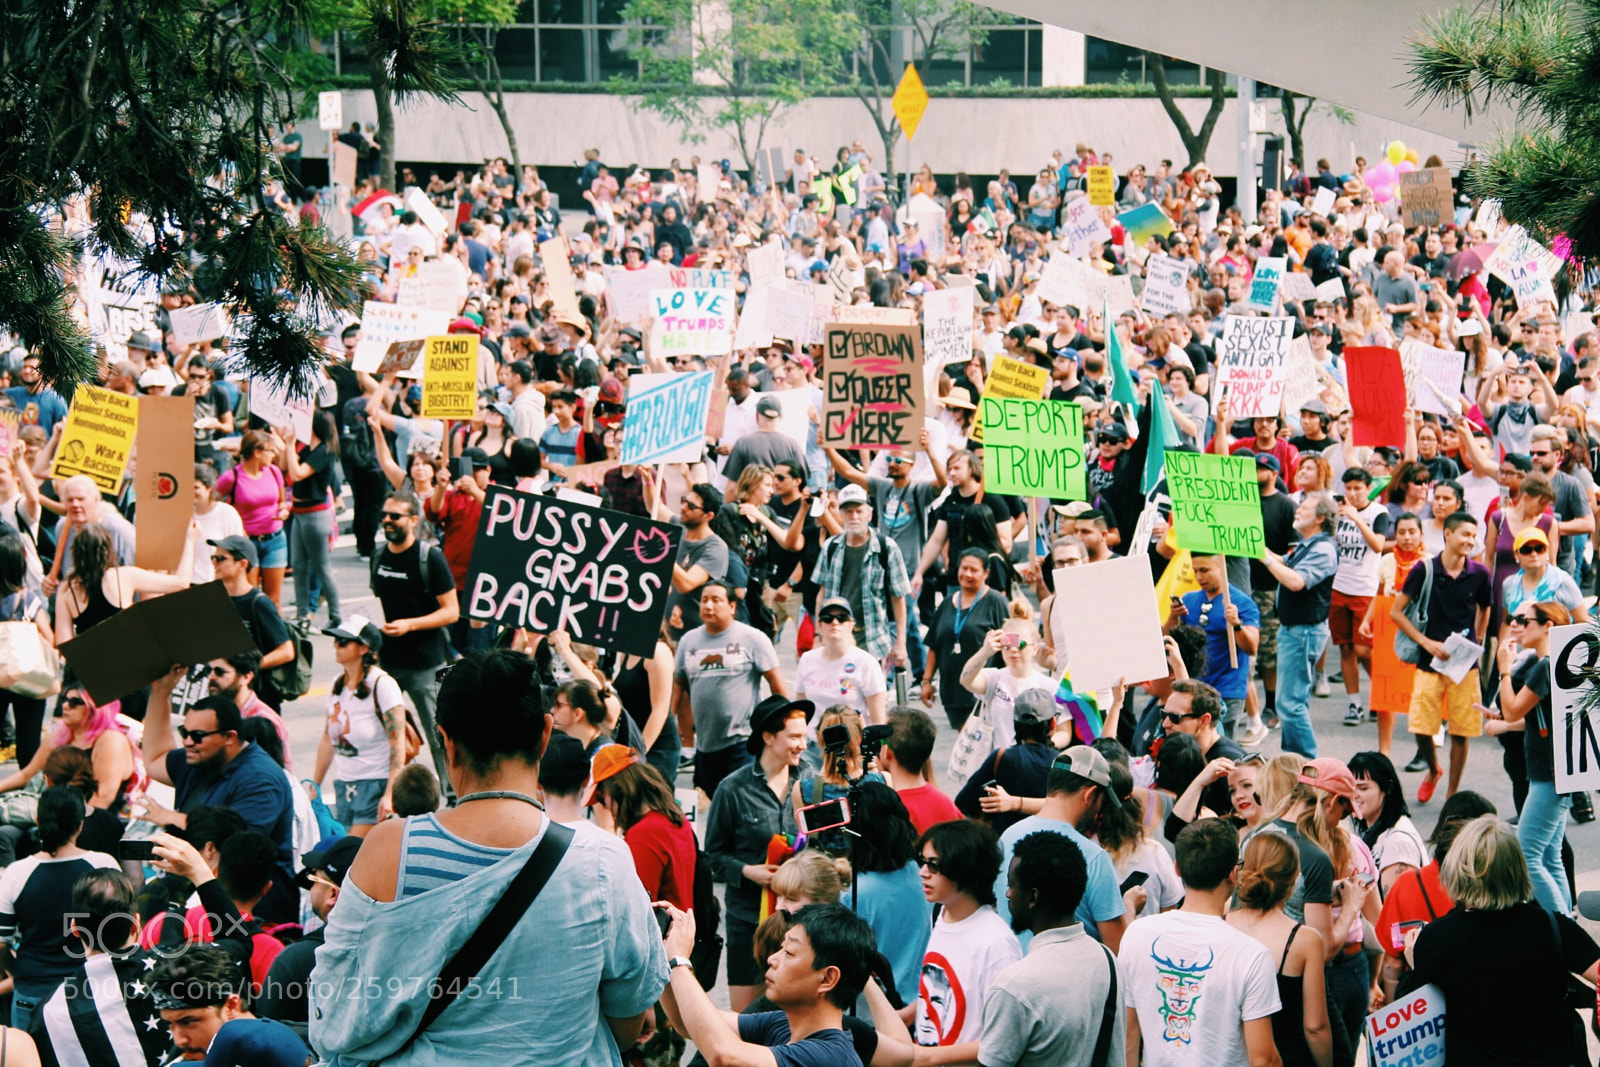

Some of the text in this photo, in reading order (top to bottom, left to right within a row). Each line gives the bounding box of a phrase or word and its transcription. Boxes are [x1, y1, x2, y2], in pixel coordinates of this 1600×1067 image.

[1150, 271, 1168, 281] FIGHT
[1146, 288, 1161, 297] FOR
[1162, 291, 1176, 301] THE
[656, 291, 727, 317] LOVE
[937, 316, 957, 328] THE
[1233, 319, 1288, 337] RACIST
[432, 340, 468, 354] STAND
[851, 332, 915, 363] BROWN
[1225, 335, 1286, 352] SEXIST
[429, 358, 471, 371] AGAINST
[1001, 359, 1036, 378] Fight Back
[1229, 367, 1273, 379] DONALD
[425, 381, 474, 392] ANTI-MUSLIM
[991, 370, 1013, 385] Against
[851, 373, 916, 410] QUEER
[1219, 380, 1283, 396] TRUMP IS
[108, 395, 130, 408] Back
[428, 395, 470, 407] BIGOTRY!
[1228, 395, 1264, 417] KKK
[851, 407, 913, 445] HERE
[984, 397, 1082, 436] DEPORT
[95, 444, 124, 462] War &
[83, 456, 121, 476] Racism
[985, 445, 1081, 491] TRUMP
[1165, 451, 1244, 479] NOT MY
[1172, 475, 1259, 504] PRESIDENT
[1173, 499, 1217, 523] FUCK
[485, 492, 629, 562] PUSSY
[1207, 525, 1263, 556] TRUMP
[526, 549, 662, 612] GRABS
[468, 571, 620, 643] BACK !!
[726, 642, 741, 655] CA
[1371, 997, 1428, 1037] Love
